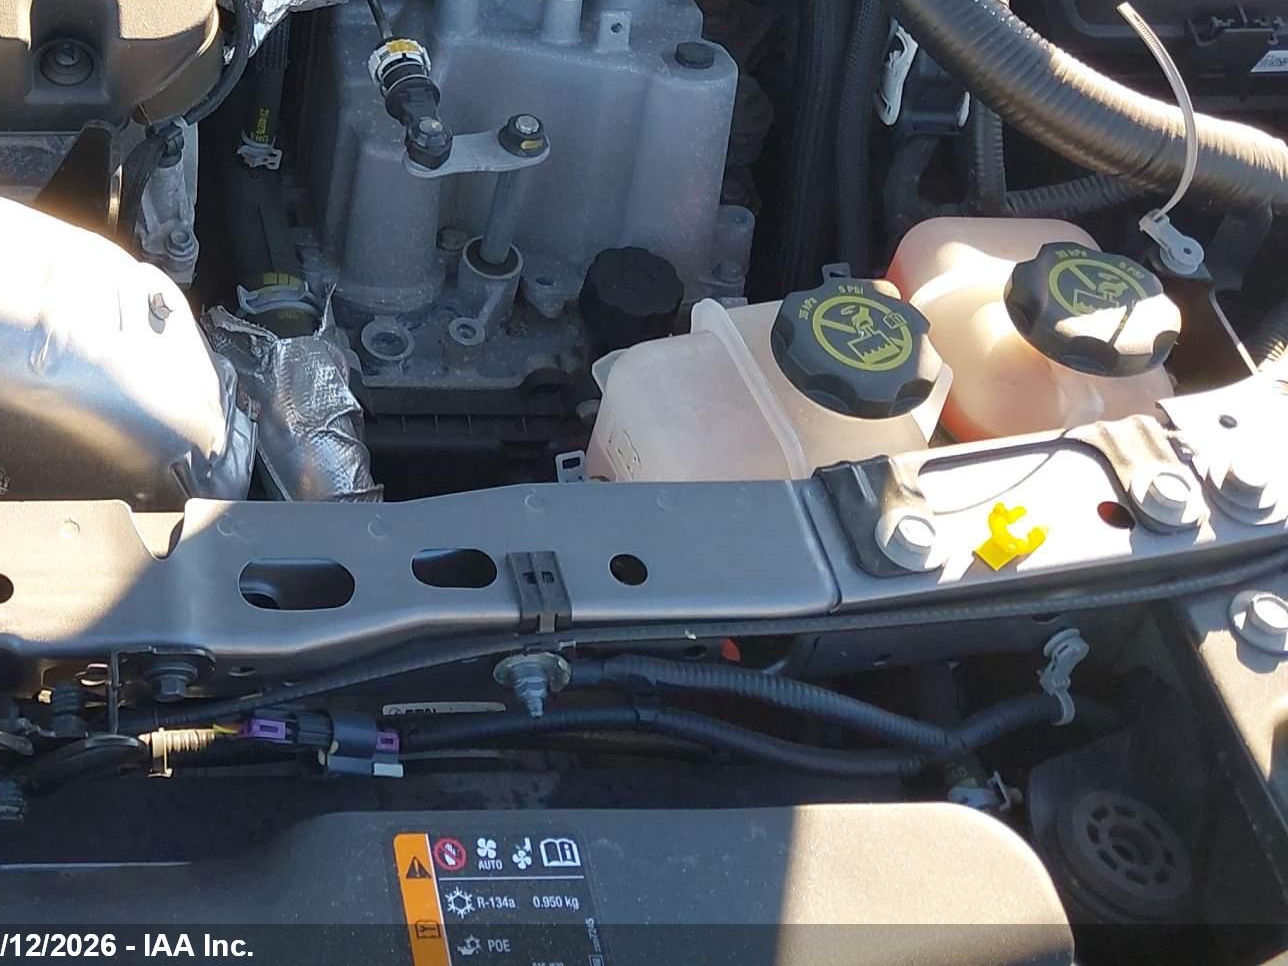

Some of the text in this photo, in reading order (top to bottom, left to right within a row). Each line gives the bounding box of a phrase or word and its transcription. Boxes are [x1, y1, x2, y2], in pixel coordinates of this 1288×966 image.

[478, 859, 503, 870] AUTO
[476, 895, 580, 911] R-134a 0.950 kg
[487, 939, 511, 953] POE
